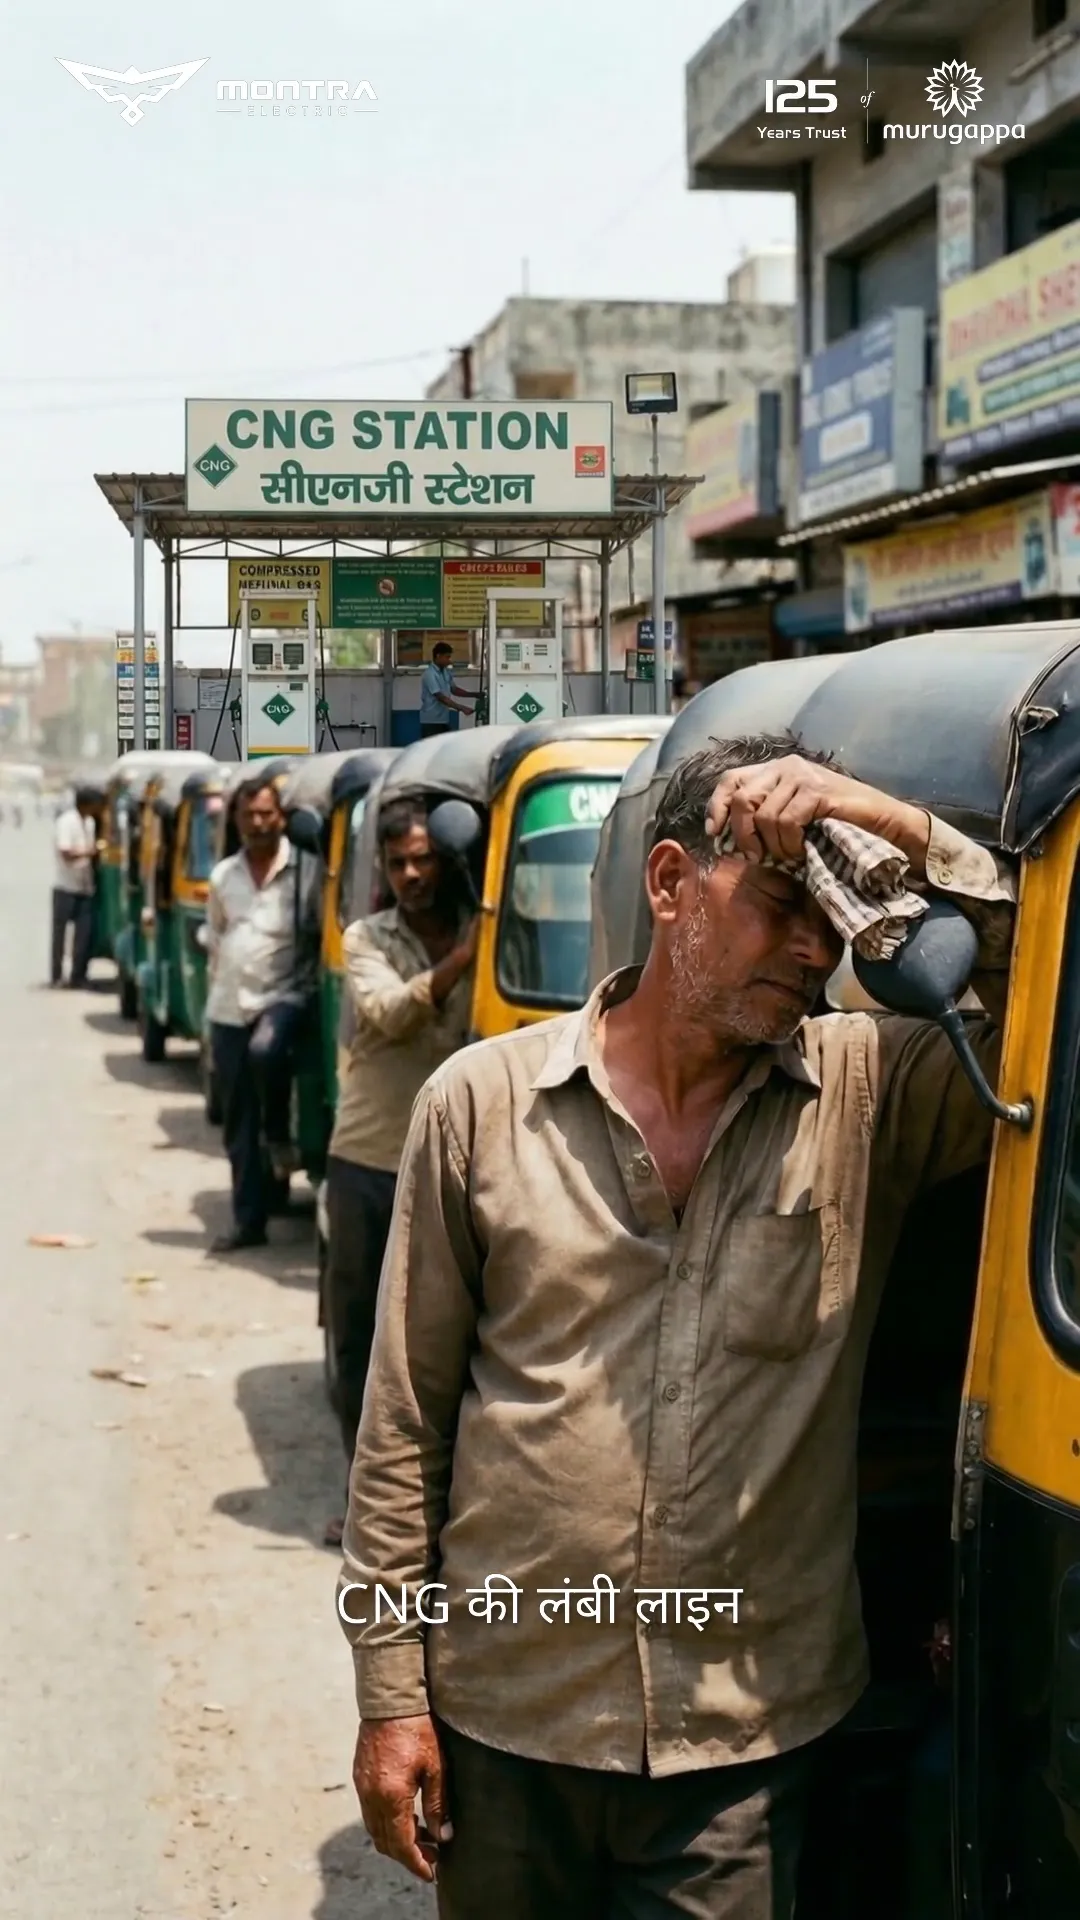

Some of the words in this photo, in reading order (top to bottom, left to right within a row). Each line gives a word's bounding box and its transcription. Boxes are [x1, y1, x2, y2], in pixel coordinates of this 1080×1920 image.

[227, 409, 335, 450] CNG
[353, 410, 570, 450] STATION
[199, 458, 231, 473] CNG
[260, 460, 413, 506] सीएनजी
[424, 461, 535, 506] स्टेशन
[238, 564, 321, 577] COMPRESSED
